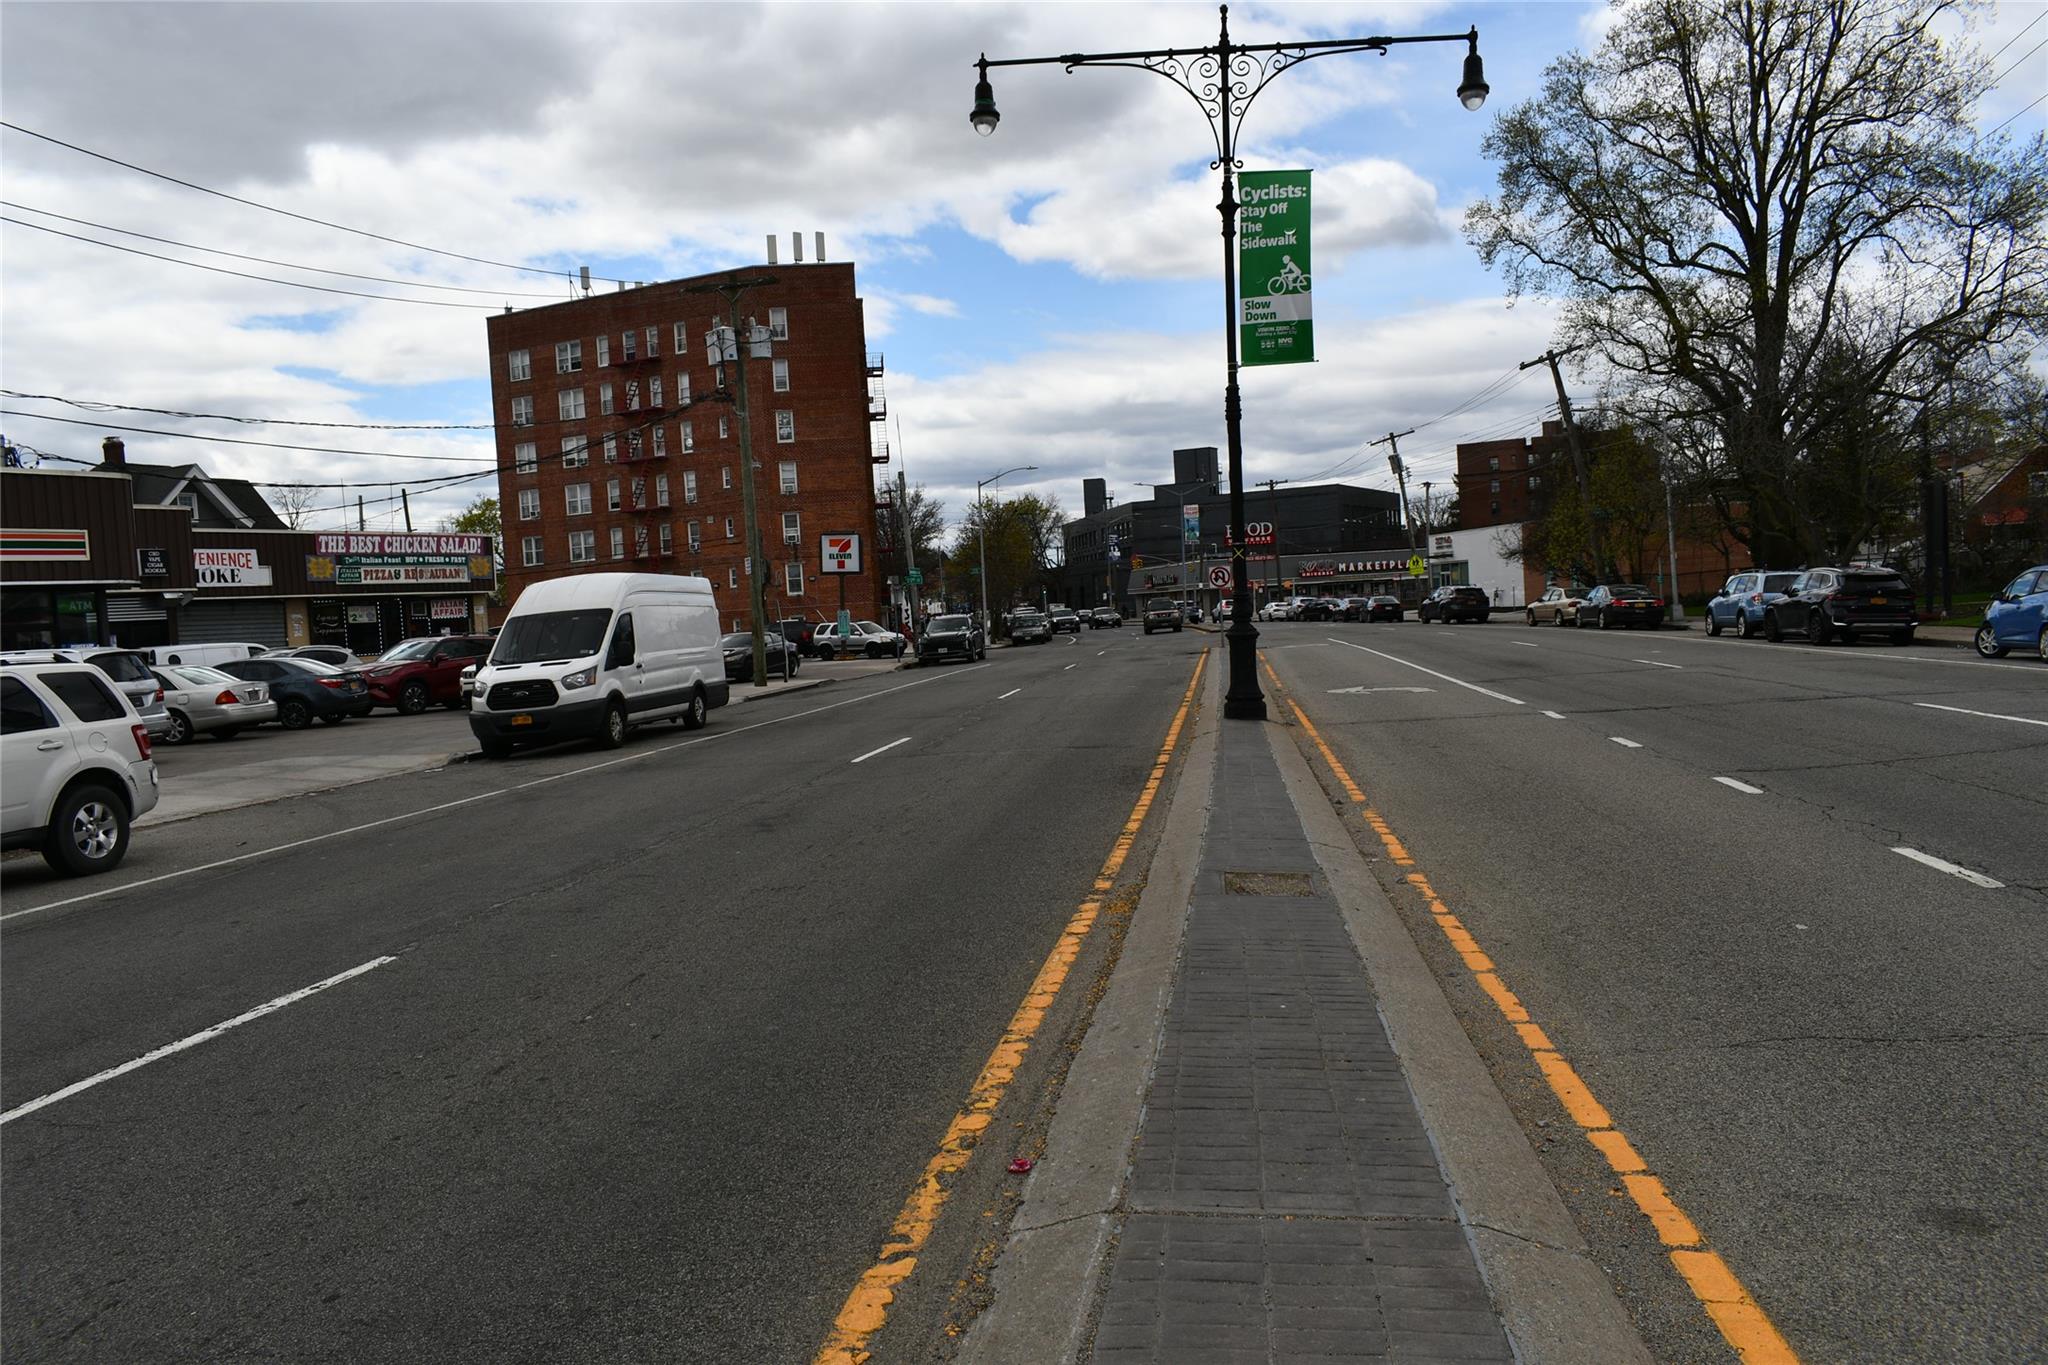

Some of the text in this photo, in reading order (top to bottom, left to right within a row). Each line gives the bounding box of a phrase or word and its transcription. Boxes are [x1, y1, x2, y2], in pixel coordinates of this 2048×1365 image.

[1240, 184, 1307, 204] Cyclists:
[1241, 202, 1288, 219] Stay Off
[1241, 222, 1263, 234] The
[1241, 234, 1297, 250] Sidewalk
[1245, 300, 1271, 311] Slow
[1245, 311, 1277, 322] Down
[319, 536, 481, 554] THE BEST CHICKEN SALAD!
[1338, 558, 1429, 572] MARKETPLAE
[363, 569, 394, 580] PIZZA
[70, 601, 93, 610] ATM
[433, 608, 464, 616] AFFAIR
